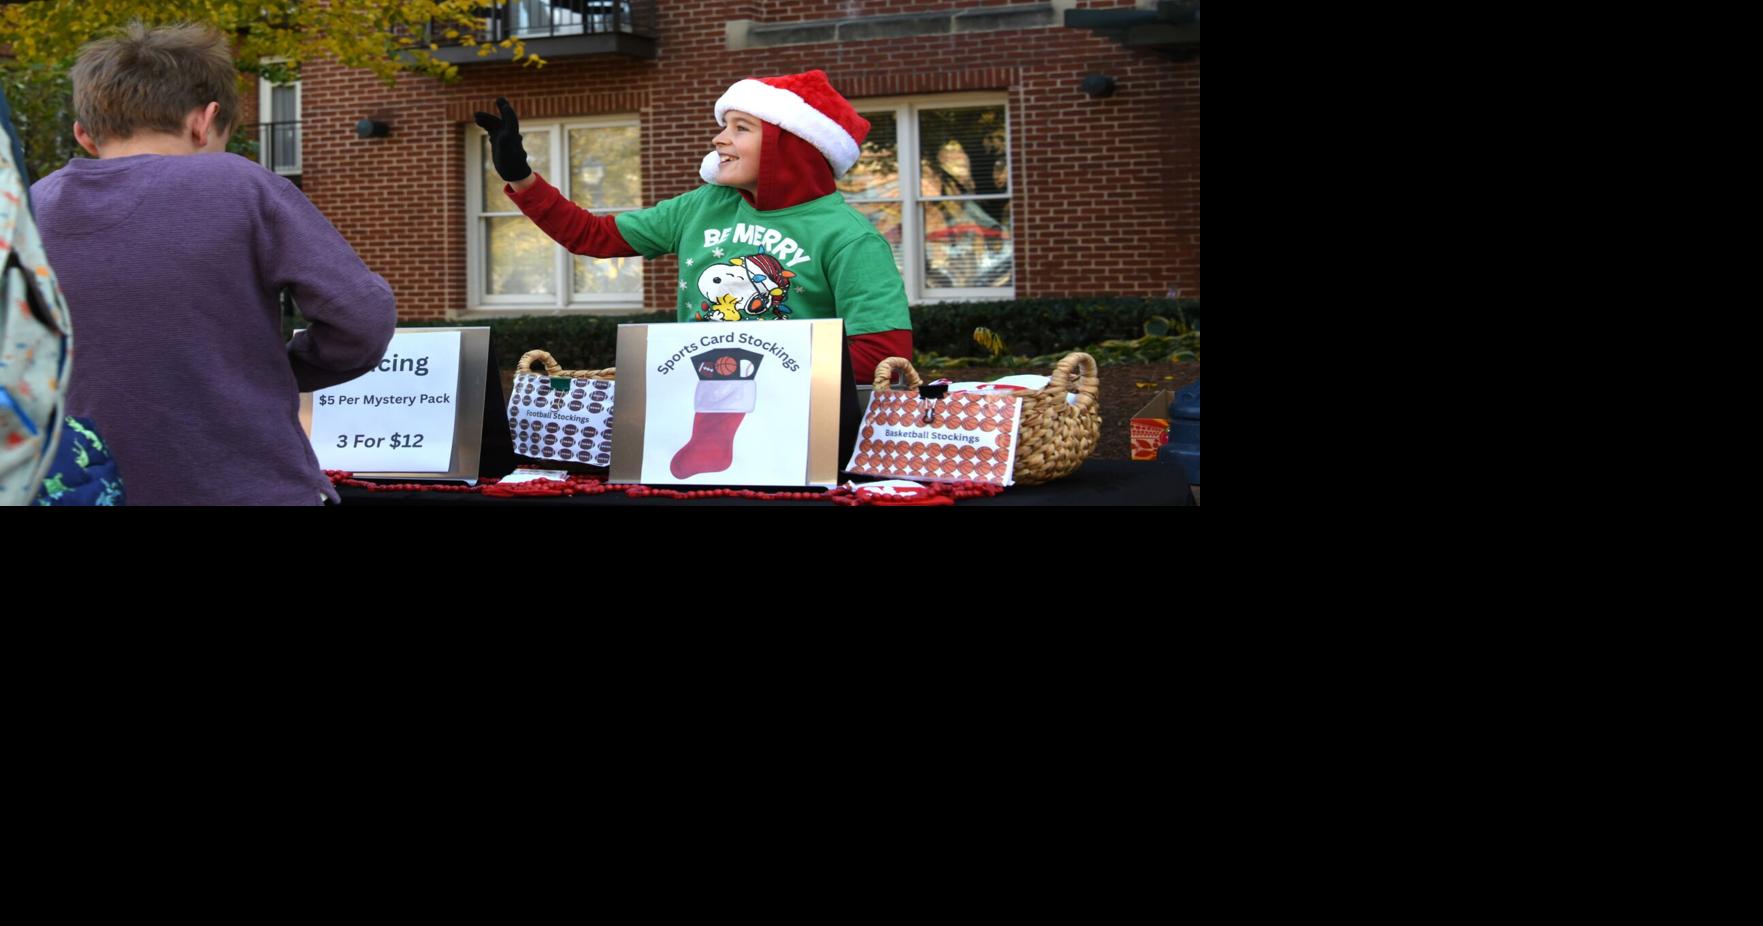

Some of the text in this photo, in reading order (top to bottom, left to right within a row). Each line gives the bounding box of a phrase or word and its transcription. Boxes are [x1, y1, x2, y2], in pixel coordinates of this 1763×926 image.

[703, 223, 811, 267] BE MERRY
[657, 332, 800, 375] Sports Card Stockings
[371, 354, 429, 376] cing
[319, 393, 450, 407] $5 Per Mystery Pack
[526, 410, 590, 424] Football Stockings
[336, 432, 424, 450] 3 For $12
[885, 429, 980, 444] Basketball Stockings
